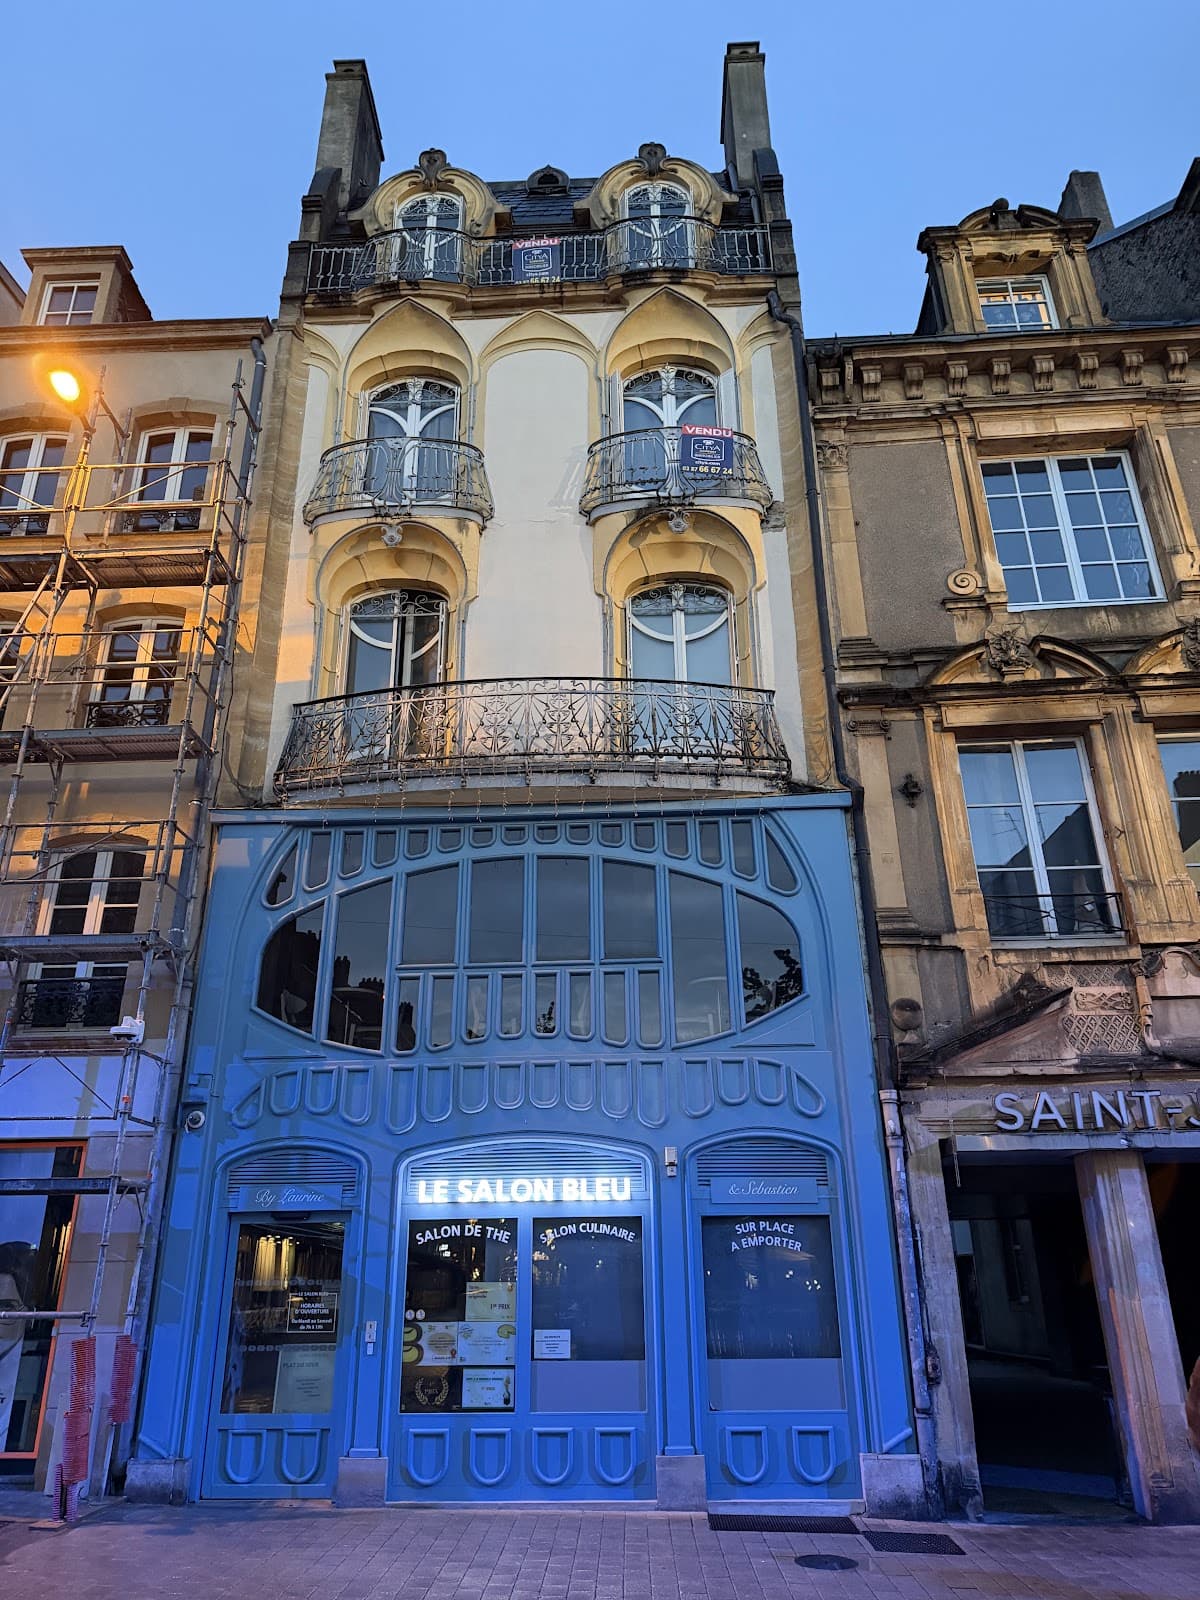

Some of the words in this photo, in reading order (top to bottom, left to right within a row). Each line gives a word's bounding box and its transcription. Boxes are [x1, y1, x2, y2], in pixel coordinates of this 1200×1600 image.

[516, 239, 558, 249] VENDU
[685, 426, 732, 438] VENDU
[417, 1179, 449, 1204] LE
[457, 1178, 554, 1203] SALON
[561, 1177, 632, 1201] BLEU
[728, 1183, 740, 1195] &
[255, 1189, 277, 1208] By
[279, 1187, 325, 1205] Laurine
[415, 1224, 461, 1246] SALON
[464, 1224, 482, 1237] DE
[486, 1226, 512, 1244] THE
[539, 1223, 577, 1243] SALON
[579, 1222, 636, 1243] CULINAIRE
[735, 1221, 757, 1235] SUR
[759, 1221, 795, 1235] PLACE
[731, 1241, 740, 1252] A
[741, 1236, 802, 1252] EMPORTER
